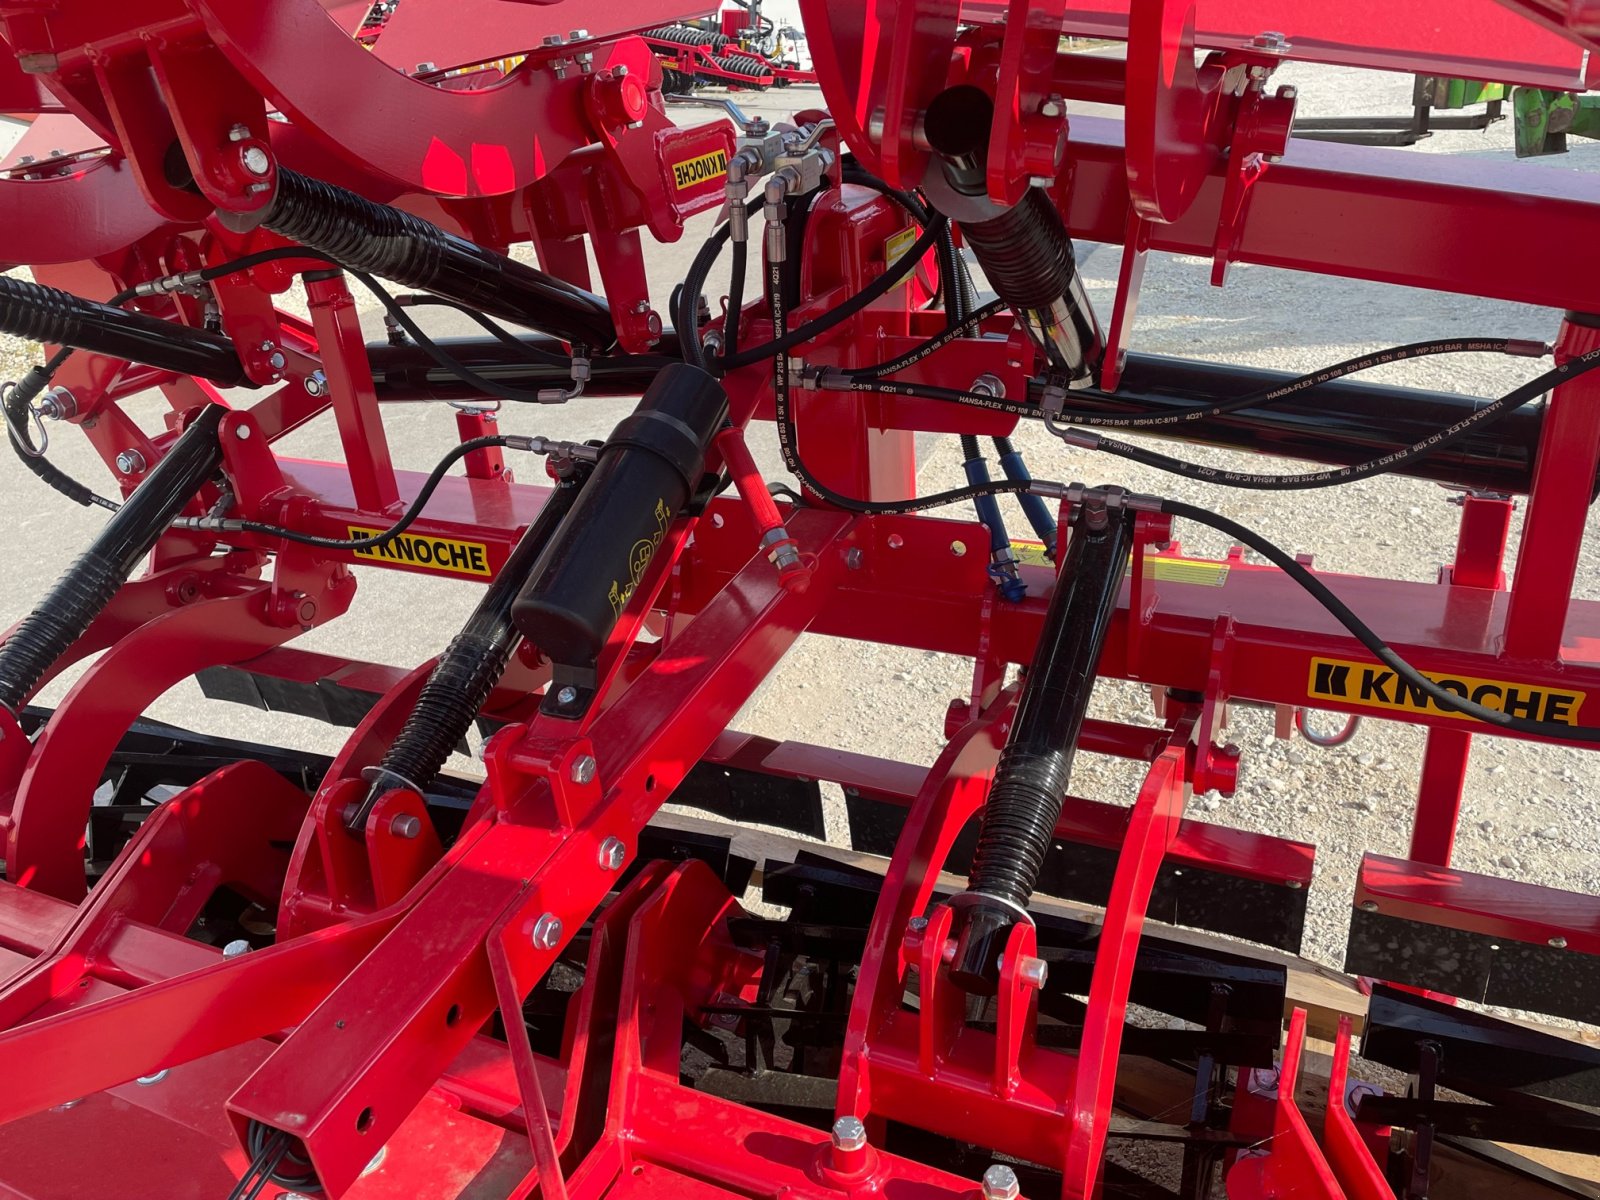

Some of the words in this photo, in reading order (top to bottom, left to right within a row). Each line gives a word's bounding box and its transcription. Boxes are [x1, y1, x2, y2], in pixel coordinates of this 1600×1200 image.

[675, 155, 719, 186] KNOCHE
[772, 266, 780, 285] 4Q21
[773, 293, 782, 318] IC-8/19
[877, 354, 919, 377] HANSA-FLEX
[920, 347, 931, 357] HD
[931, 341, 942, 351] 108
[944, 333, 954, 343] EN
[953, 327, 964, 338] 853
[964, 321, 969, 330] 1
[968, 317, 978, 327] SN
[980, 311, 988, 320] 08
[776, 360, 784, 373] 215
[776, 374, 784, 386] WP
[879, 385, 897, 393] 4Q21
[959, 396, 1002, 410] HANSA-FLEX
[1006, 404, 1017, 413] HD
[1017, 406, 1028, 415] 108
[1032, 409, 1041, 417] EN
[1060, 414, 1071, 422] SN
[1103, 418, 1113, 426] 215
[1133, 418, 1154, 426] MSHA
[1155, 416, 1178, 425] IC-8/19
[1185, 412, 1203, 421] 4Q21
[1266, 378, 1314, 400] HANSA-FLEX
[1317, 373, 1329, 383] HD
[1329, 369, 1342, 380] 108
[1347, 364, 1358, 373] EN
[1359, 359, 1373, 370] 853
[1380, 354, 1393, 363] SN
[1397, 350, 1407, 358] 08
[1415, 347, 1430, 355] WP
[1430, 344, 1444, 353] 215
[1444, 343, 1462, 351] BAR
[1467, 342, 1492, 351] MSHA
[1447, 399, 1504, 436] HANSA-FLEX
[1428, 433, 1443, 445] HD
[1412, 440, 1428, 453] 108
[1378, 454, 1395, 466] 853
[1394, 449, 1409, 461] EN
[1197, 467, 1217, 477] 4Q21
[1340, 467, 1351, 476] 08
[1355, 463, 1369, 473] SN
[1225, 472, 1251, 482] IC-8/19
[1252, 475, 1277, 484] MSHA
[1281, 474, 1300, 483] BAR
[1301, 473, 1315, 482] 215
[1315, 471, 1331, 480] WP
[377, 534, 487, 572] KNOCHE
[1360, 669, 1576, 727] KNOCHE
